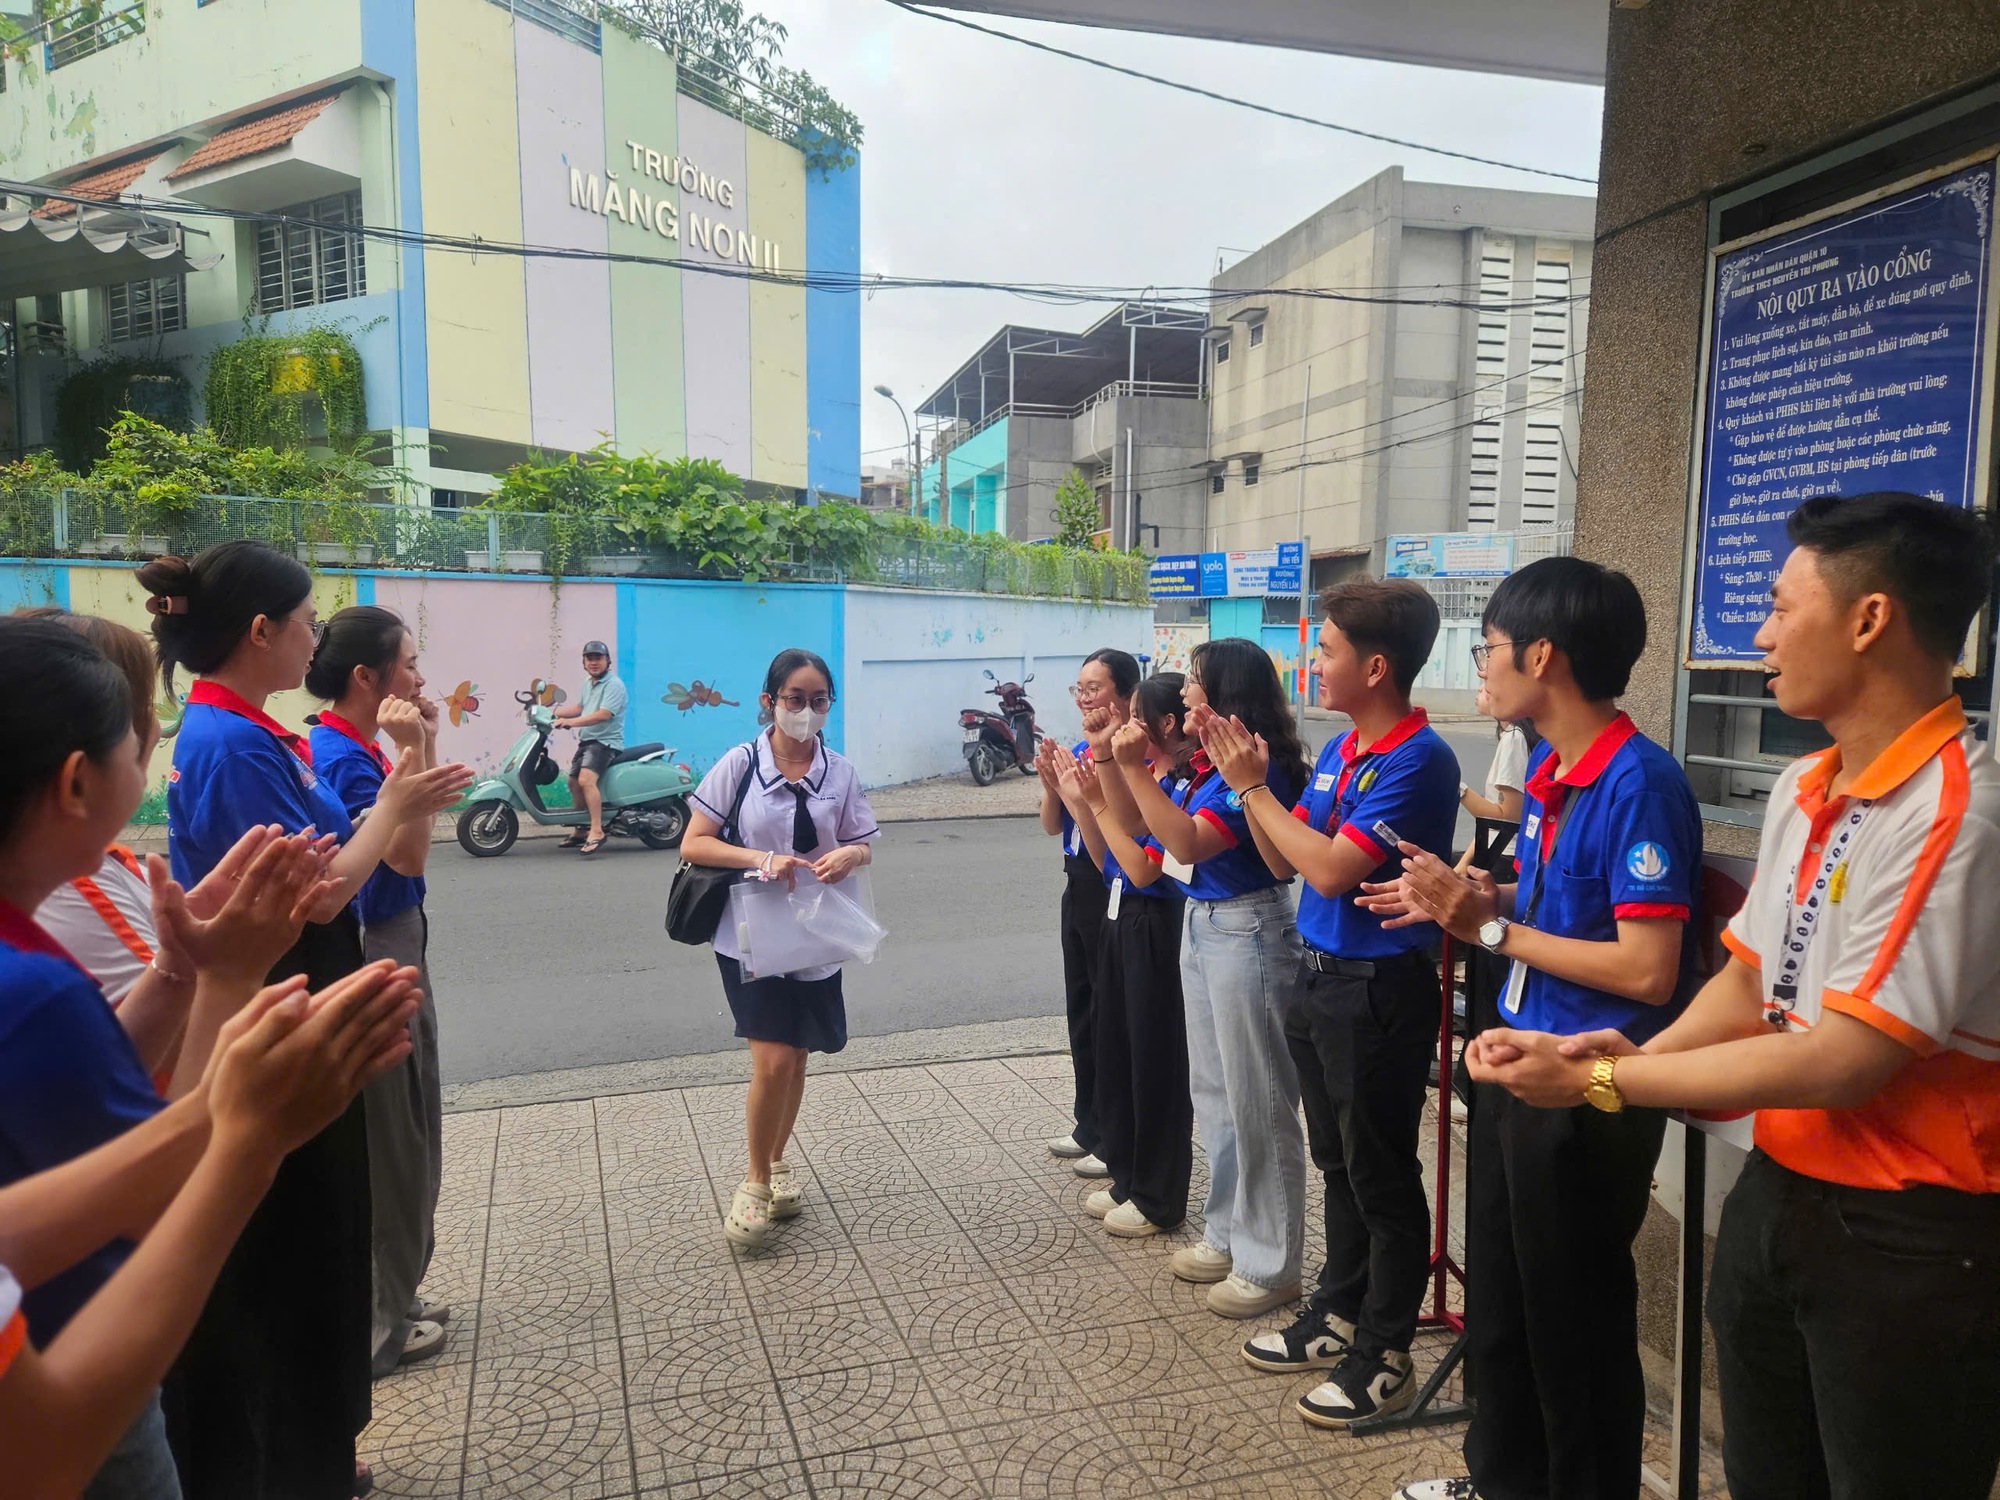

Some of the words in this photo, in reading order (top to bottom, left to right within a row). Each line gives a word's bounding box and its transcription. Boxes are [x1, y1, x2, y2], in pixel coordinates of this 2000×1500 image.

[626, 139, 734, 209] TRƯỜNG
[569, 166, 679, 240] MĂNG
[689, 212, 757, 268] NON
[1757, 292, 1783, 321] NỘI
[1787, 284, 1817, 314] QUY
[1820, 277, 1842, 301] RA
[1846, 263, 1879, 293] VÀO
[1884, 245, 1932, 282] CỔNG
[1724, 340, 1730, 351] 1.
[1731, 335, 1743, 349] Vui
[1745, 333, 1761, 346] lòng
[1762, 324, 1785, 341] xuống
[1786, 324, 1797, 334] xe,
[1799, 314, 1810, 331] tắt
[1811, 313, 1830, 327] máy,
[1849, 303, 1862, 318] bộ,
[1864, 296, 1874, 313] để
[1876, 299, 1886, 310] xe
[1888, 290, 1911, 306] đúng
[1930, 281, 1947, 297] quy
[1949, 271, 1973, 291] định.
[1720, 379, 1727, 391] 3.
[1728, 375, 1752, 389] Không
[1772, 365, 1793, 379] mang
[1794, 358, 1806, 374] bất
[1808, 357, 1818, 372] kỳ
[1820, 353, 1831, 367] tài
[1849, 346, 1865, 361] nào
[1866, 346, 1876, 357] ra
[1931, 323, 1949, 341] nếu
[1722, 360, 1728, 371] 2.
[1730, 356, 1751, 369] Trang
[1752, 350, 1771, 366] phục
[1772, 344, 1786, 361] lịch
[1800, 338, 1813, 351] kín
[1815, 334, 1832, 347] đáo,
[1833, 330, 1848, 343] văn
[1850, 321, 1873, 338] minh.
[1718, 419, 1724, 430] 4.
[1725, 415, 1740, 431] Quý
[1741, 410, 1764, 426] khách
[1765, 408, 1774, 420] và
[1776, 403, 1799, 419] PHHS
[1800, 400, 1813, 414] khi
[1815, 398, 1830, 411] liên
[1832, 394, 1843, 408] hệ
[1844, 390, 1857, 404] với
[1859, 387, 1875, 402] nhà
[1908, 376, 1923, 391] vui
[1925, 374, 1948, 389] lòng:
[1725, 396, 1748, 409] không
[1768, 386, 1787, 403] phép
[1788, 382, 1802, 396] của
[1804, 378, 1822, 393] hiệu
[1733, 453, 1757, 467] Không
[1787, 445, 1793, 460] ý
[1794, 444, 1809, 456] vào
[1810, 440, 1836, 457] phòng
[1836, 436, 1857, 450] hoặc
[1858, 432, 1872, 446] các
[1874, 429, 1902, 446] phòng
[1903, 423, 1924, 438] chức
[1926, 421, 1951, 435] năng.
[1735, 434, 1750, 448] Gặp
[1751, 430, 1765, 444] bảo
[1766, 428, 1775, 442] vệ
[1776, 423, 1787, 439] để
[1852, 415, 1862, 427] cụ
[1864, 406, 1880, 423] thể.
[1747, 473, 1761, 487] gặp
[1763, 467, 1787, 482] GVCN,
[1789, 462, 1815, 478] GVBM,
[1817, 460, 1829, 474] HS
[1831, 458, 1842, 474] tại
[1844, 456, 1871, 473] phòng
[1872, 450, 1889, 467] tiếp
[1891, 449, 1907, 463] dân
[1742, 493, 1757, 506] học,
[1771, 492, 1780, 501] ra
[1782, 485, 1800, 499] chơi,
[1816, 485, 1825, 495] ra
[1711, 516, 1717, 528] 5.
[1718, 513, 1740, 527] PHHS
[1741, 510, 1755, 524] đến
[1756, 510, 1770, 523] đón
[1772, 511, 1785, 521] con
[1743, 532, 1758, 546] học.
[1203, 560, 1224, 574] yola
[1275, 570, 1295, 578] ĐƯỜNG
[1708, 555, 1715, 566] 6.
[1715, 553, 1731, 568] Lịch
[1733, 551, 1747, 566] tiếp
[1748, 550, 1772, 563] PHHS:
[1725, 573, 1744, 586] Sáng:
[1746, 571, 1762, 583] 7h30
[1724, 592, 1746, 606] Riêng
[1746, 591, 1764, 605] sáng
[1722, 610, 1745, 623] Chiều:
[1745, 611, 1766, 623] 13h30
